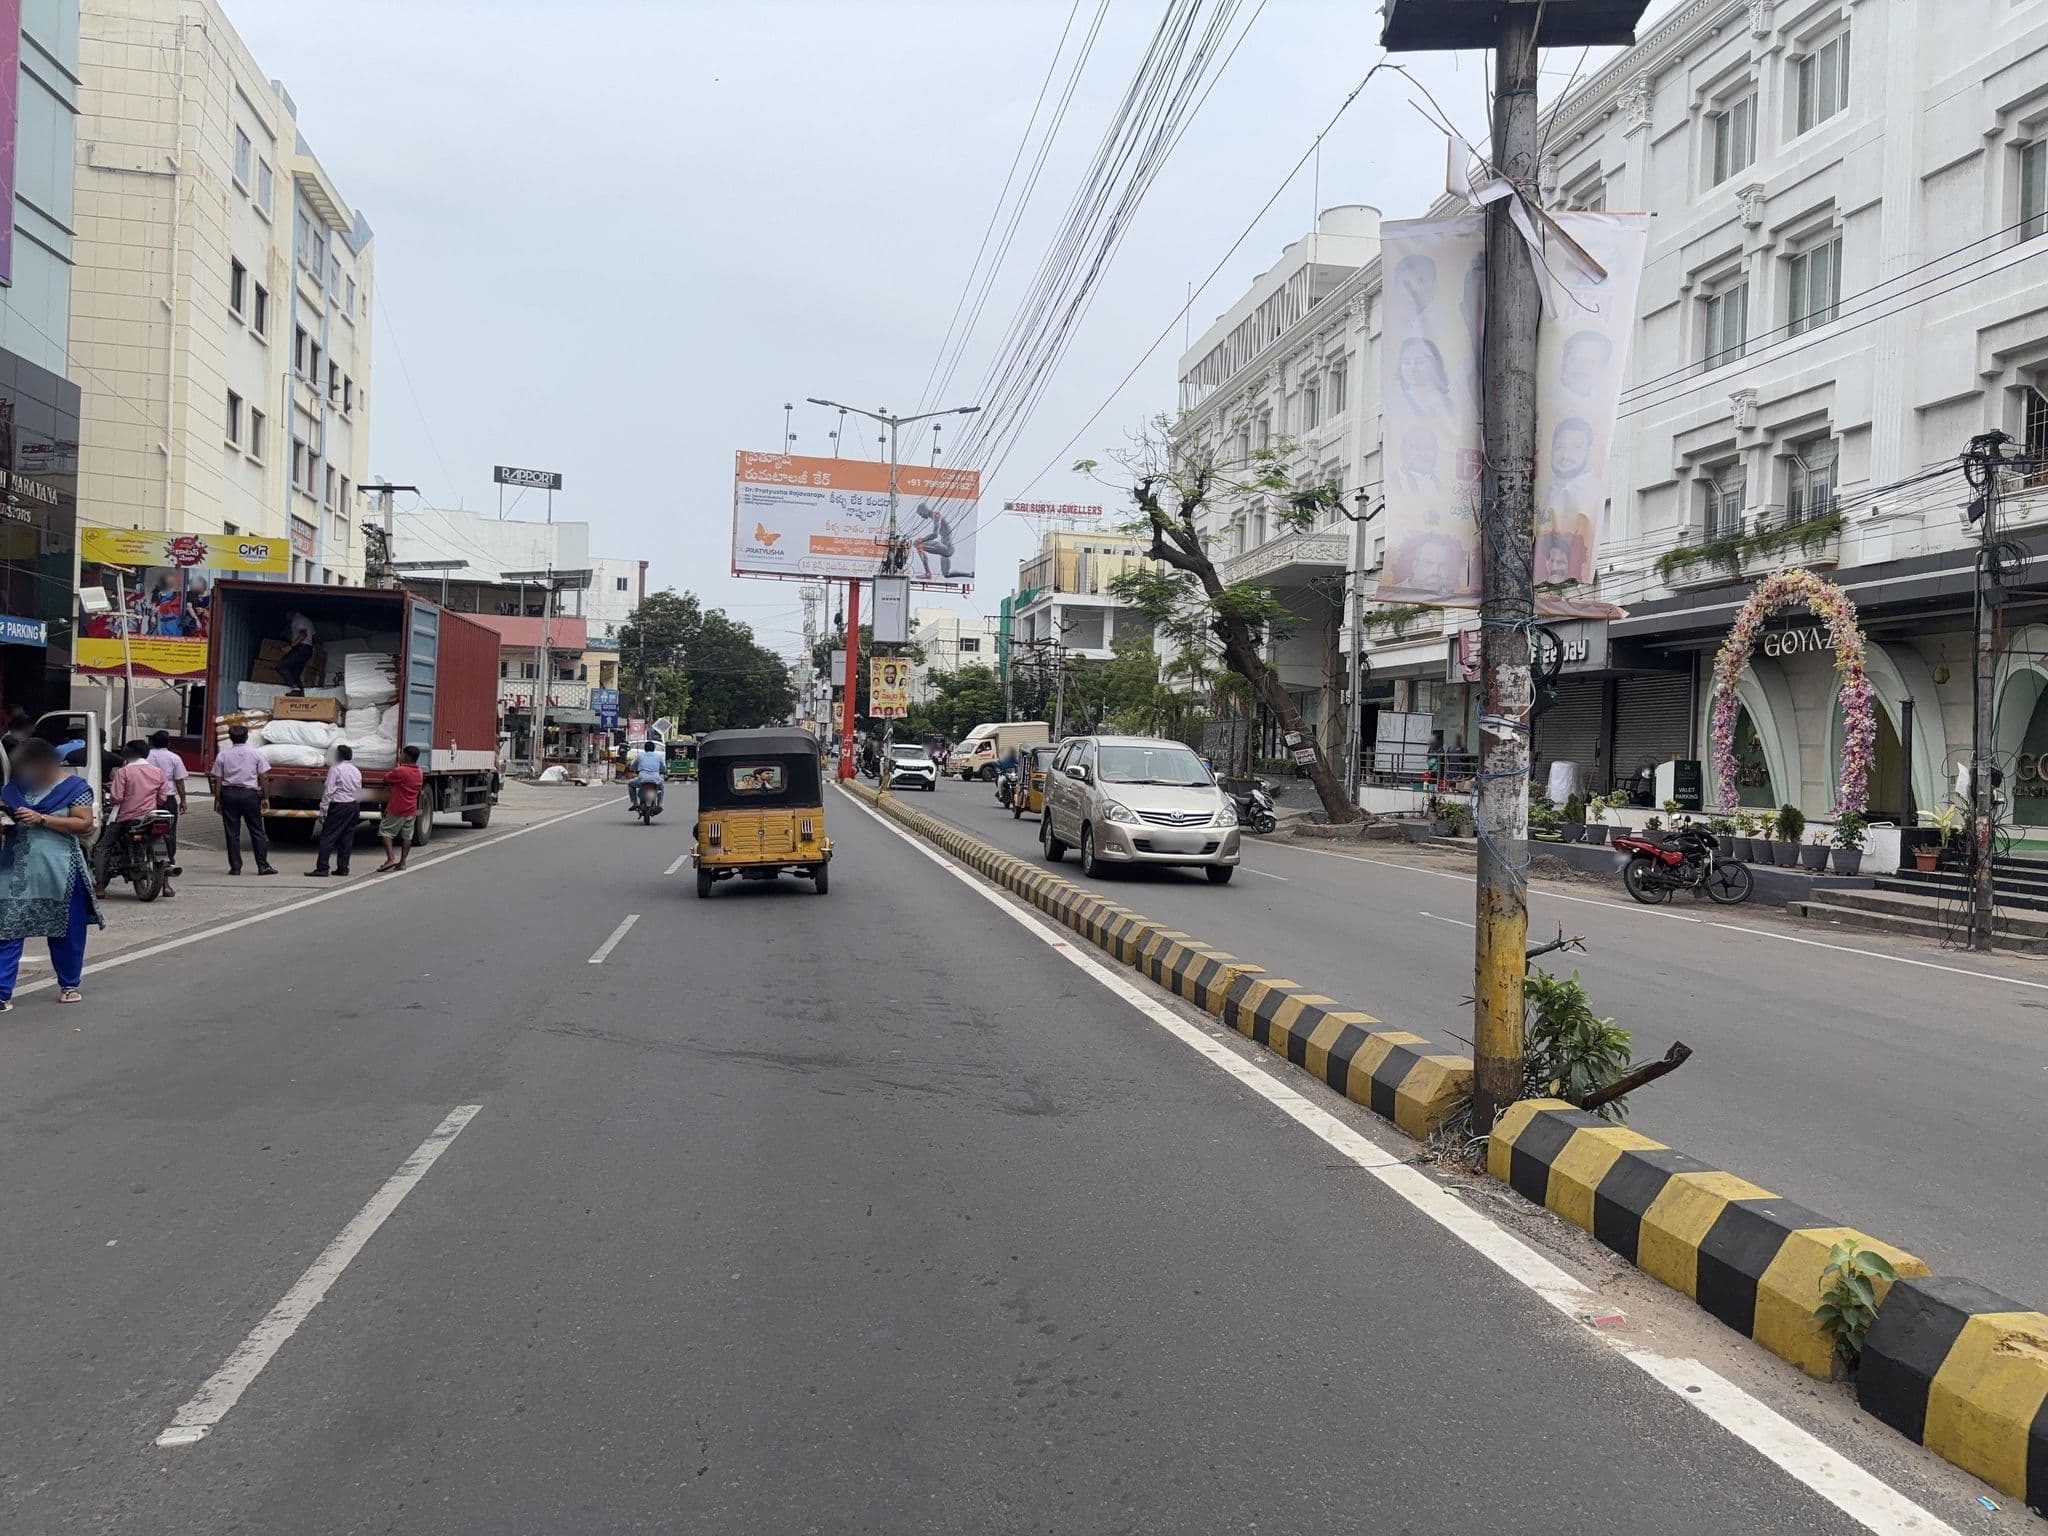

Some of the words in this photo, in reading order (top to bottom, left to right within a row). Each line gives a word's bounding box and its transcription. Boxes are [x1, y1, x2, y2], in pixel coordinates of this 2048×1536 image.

[502, 467, 555, 485] RAPPORT
[1015, 502, 1028, 512] SRI
[1031, 503, 1055, 513] SURYA
[1057, 504, 1103, 515] JEWELLERS
[238, 543, 269, 557] CMR
[746, 547, 785, 556] PRATYUSHA
[7, 621, 39, 640] PARKING
